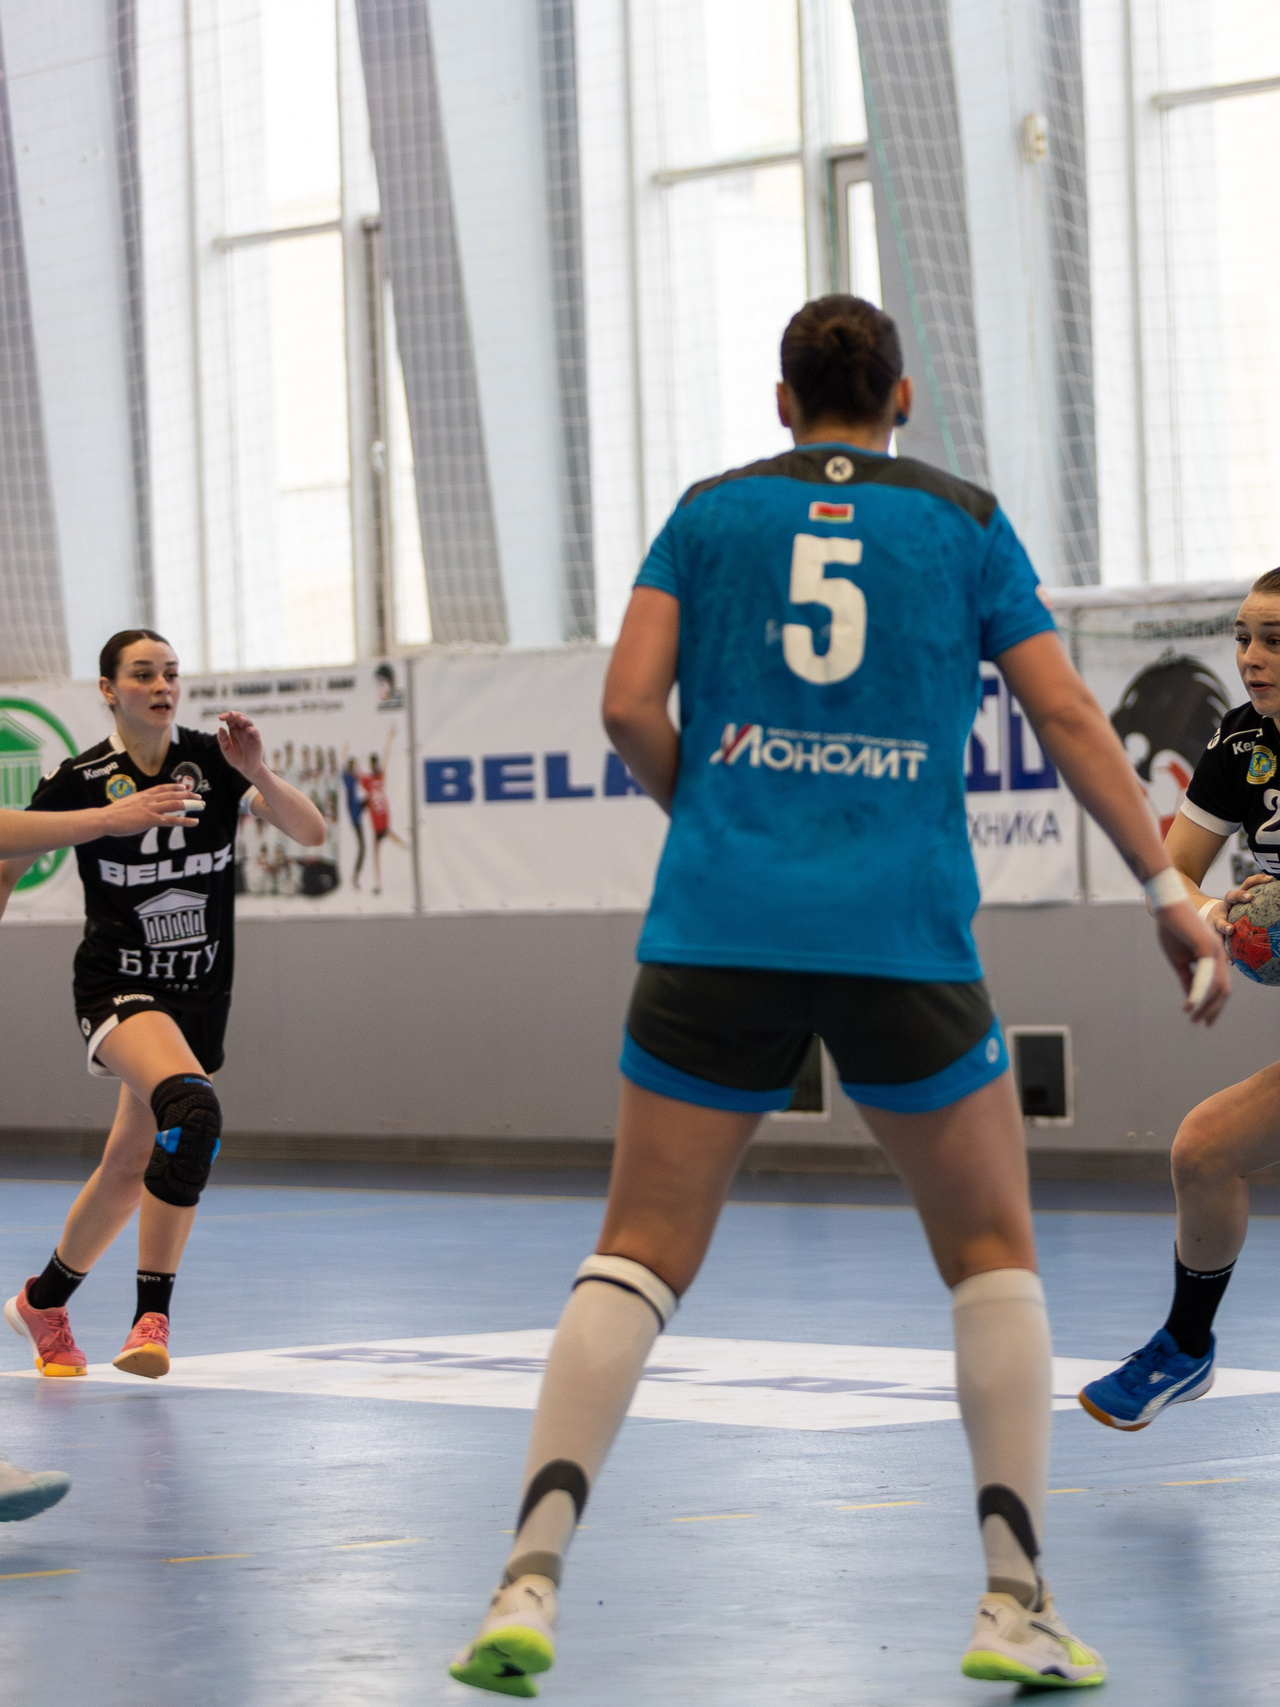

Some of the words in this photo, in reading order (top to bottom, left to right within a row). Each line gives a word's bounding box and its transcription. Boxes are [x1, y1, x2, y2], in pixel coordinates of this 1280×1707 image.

[782, 533, 867, 685] 5
[83, 761, 119, 781] Kempa
[424, 752, 651, 804] BELA
[970, 809, 1062, 848] ХНИКА
[98, 843, 234, 887] BELAZ
[118, 940, 220, 979] БНТУ
